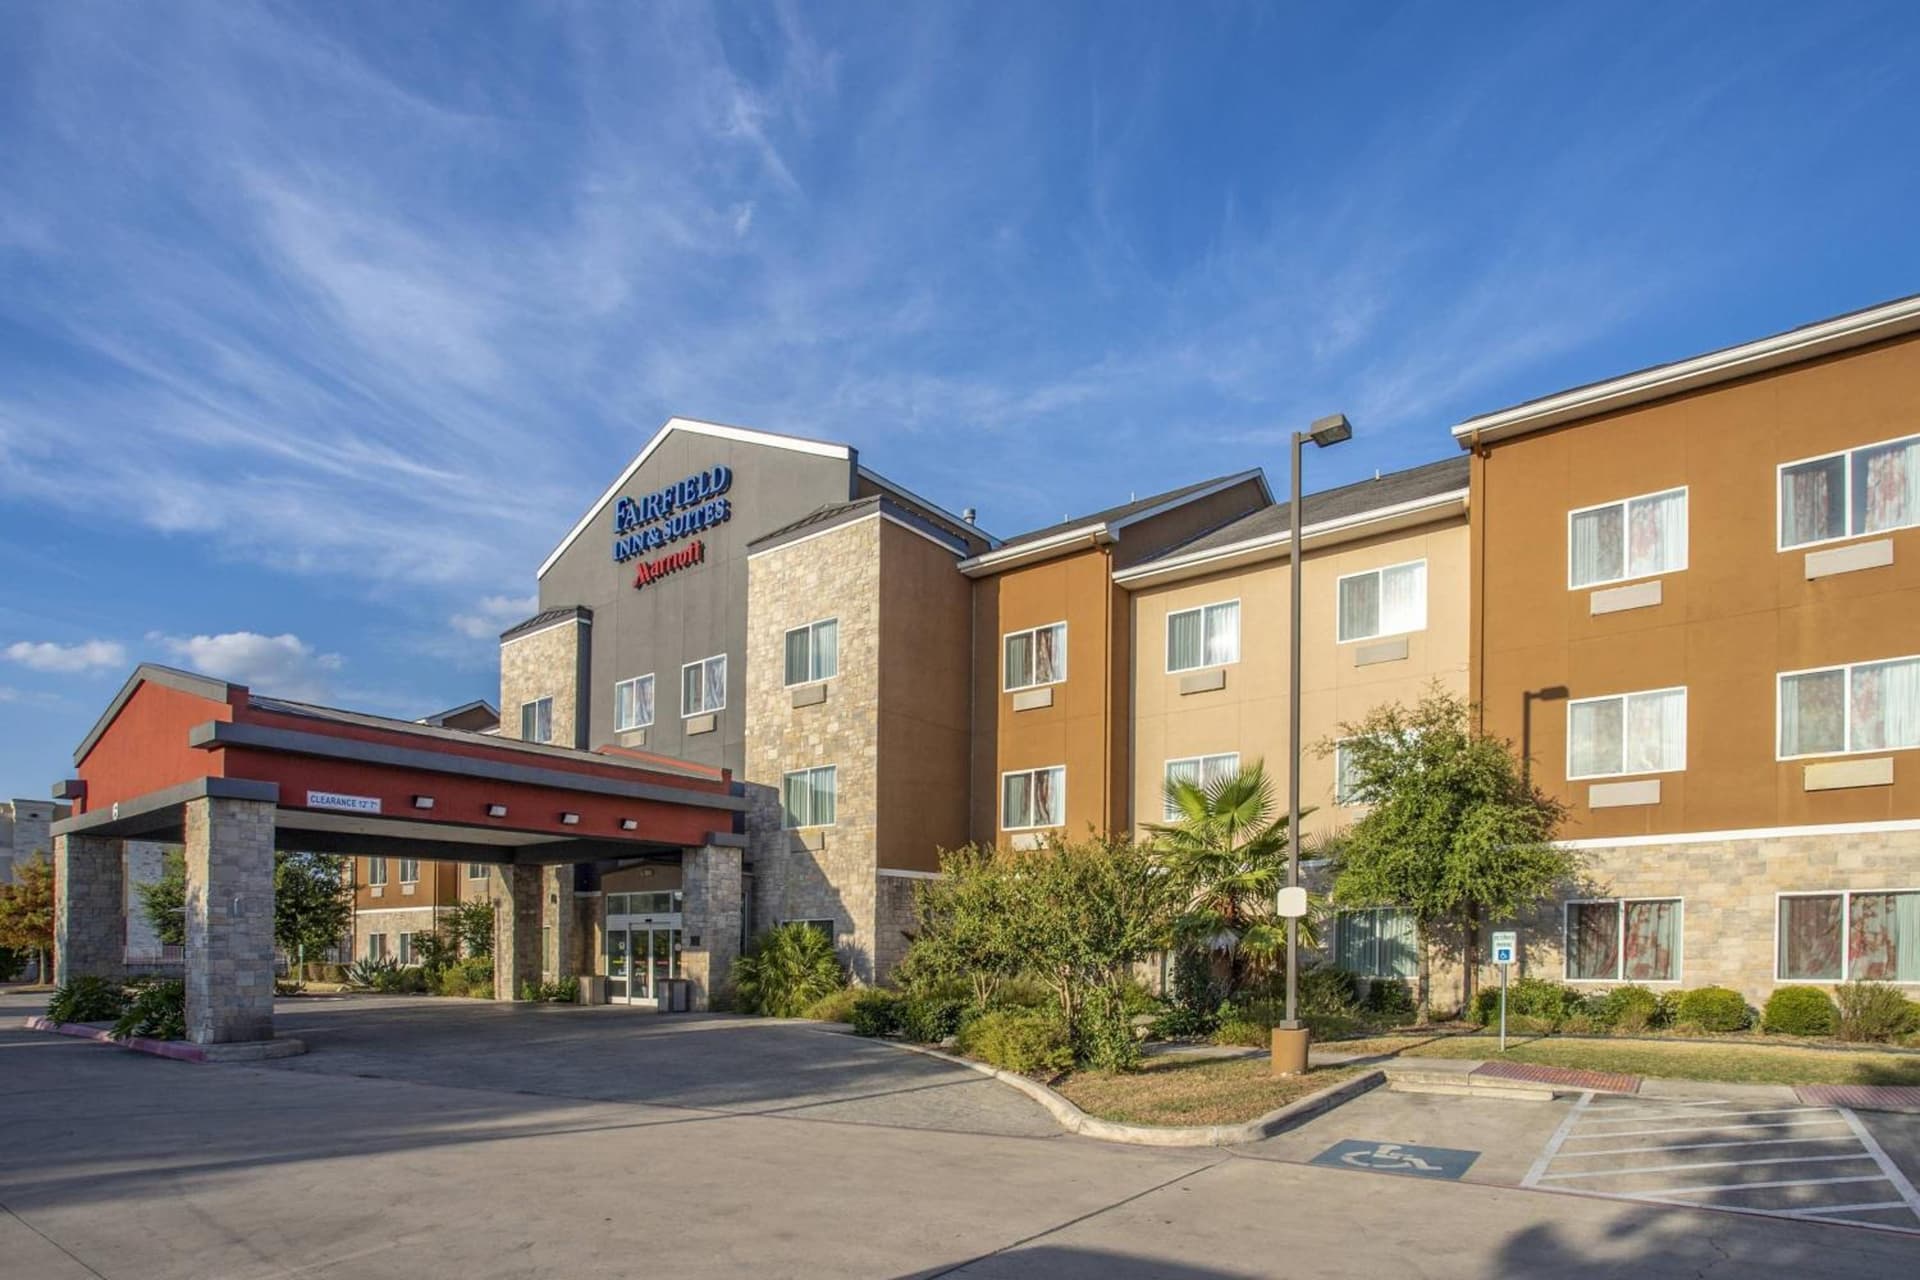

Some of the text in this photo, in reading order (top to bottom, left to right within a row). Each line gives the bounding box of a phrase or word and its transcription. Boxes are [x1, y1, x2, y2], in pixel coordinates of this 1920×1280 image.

[613, 465, 731, 534] FAIRFIELD
[612, 498, 730, 562] INN & SUITES
[634, 540, 704, 588] Marriott
[310, 795, 356, 807] CLEARANCE
